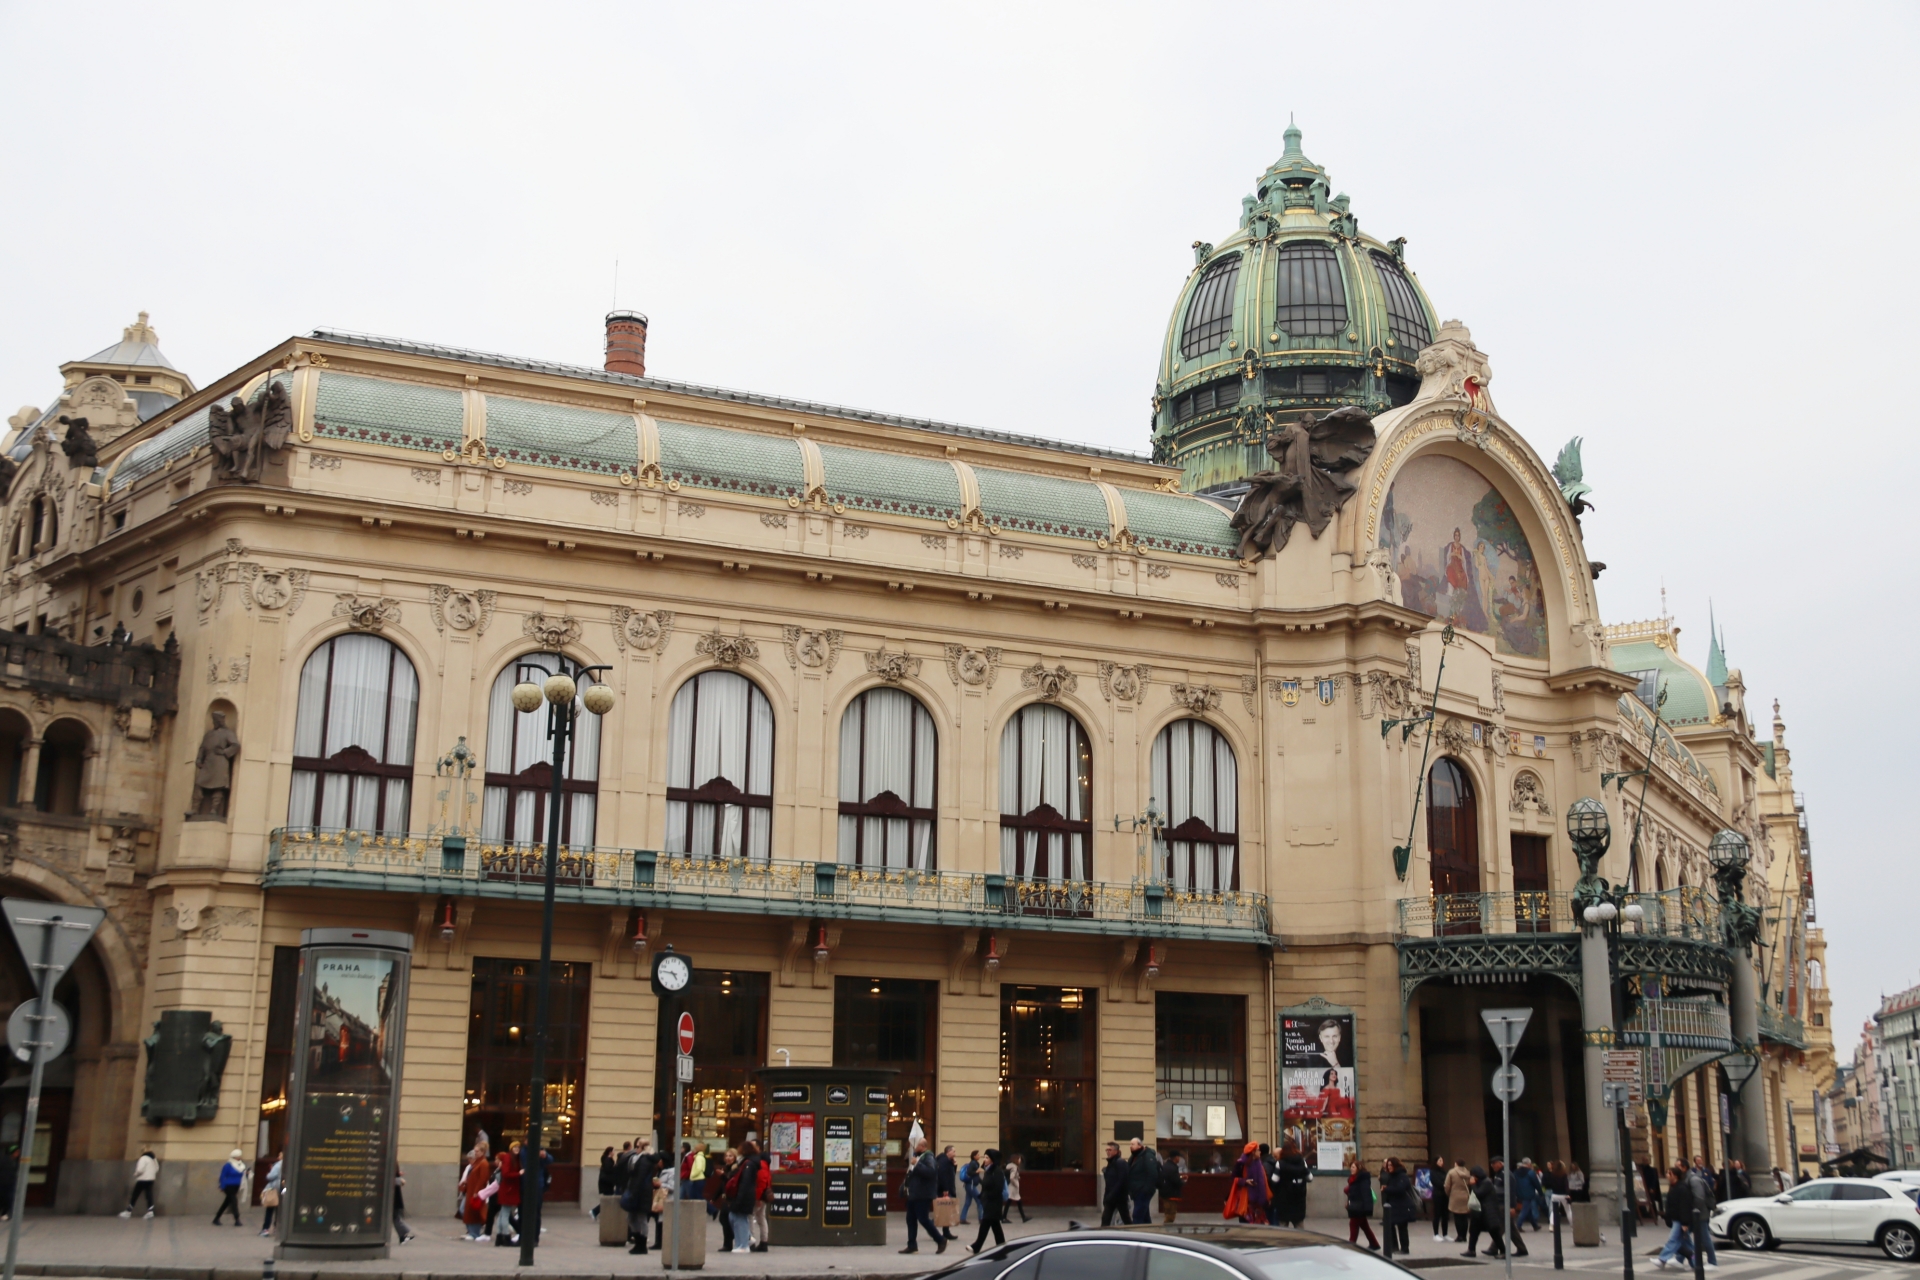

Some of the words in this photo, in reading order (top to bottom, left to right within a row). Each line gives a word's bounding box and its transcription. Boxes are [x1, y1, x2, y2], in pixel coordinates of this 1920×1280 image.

[323, 963, 360, 971] PRAHA
[1285, 1037, 1304, 1046] Tomáš
[1285, 1042, 1316, 1053] Netopil
[1294, 1071, 1319, 1079] ANGELA
[1288, 1078, 1325, 1087] GHEORGHIU
